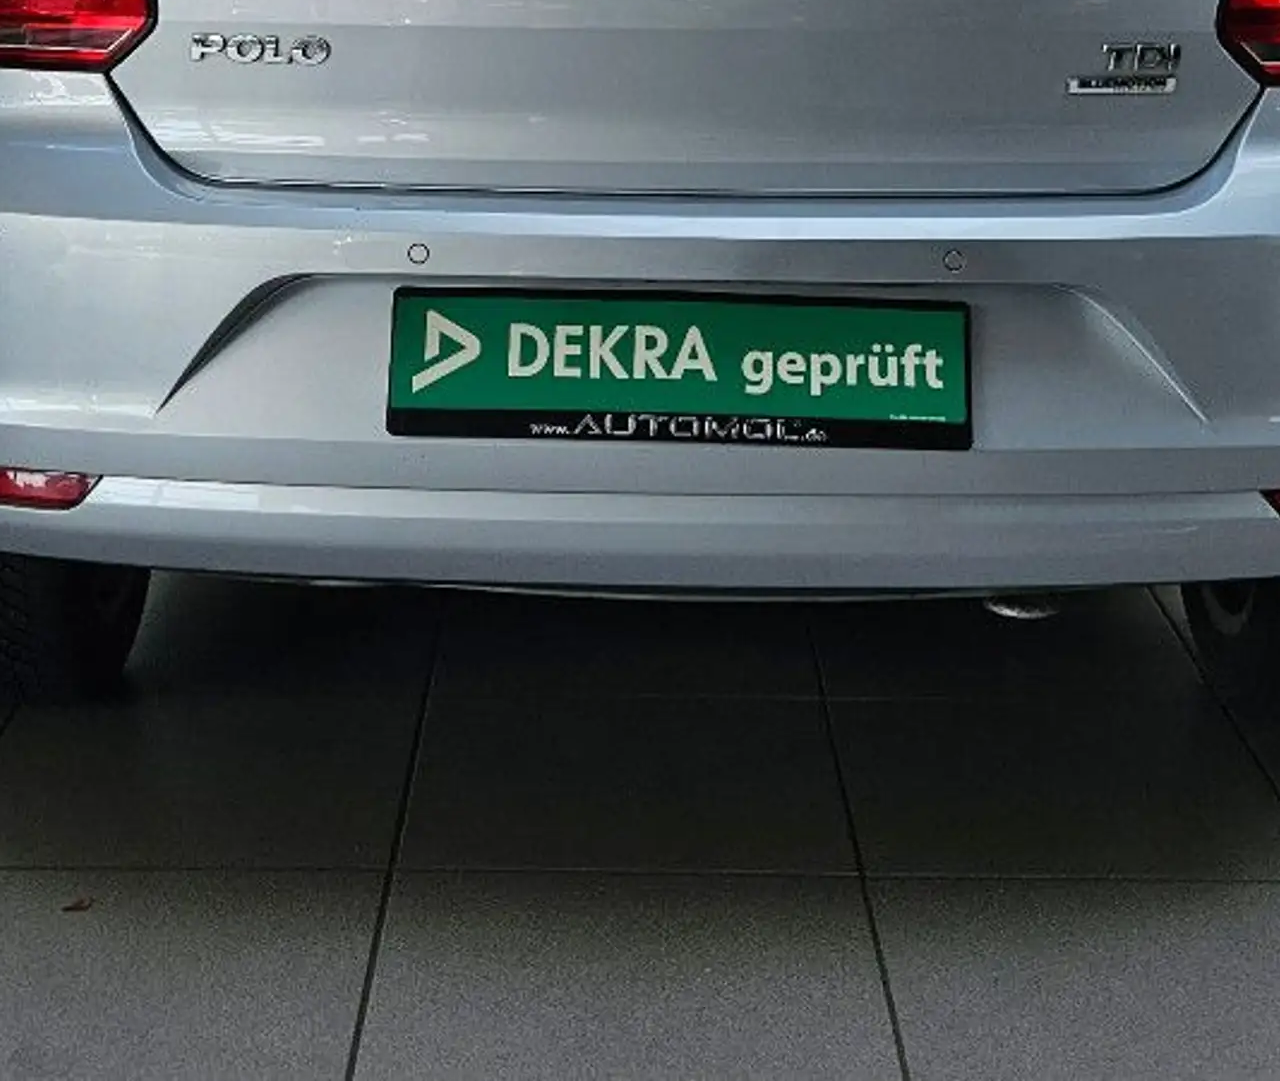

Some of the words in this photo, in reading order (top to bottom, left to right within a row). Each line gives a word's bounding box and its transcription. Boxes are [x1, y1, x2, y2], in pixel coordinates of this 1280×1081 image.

[191, 32, 332, 66] POLO
[1102, 43, 1181, 71] TDI
[507, 323, 718, 382] DEKRA
[740, 344, 944, 396] geprüft
